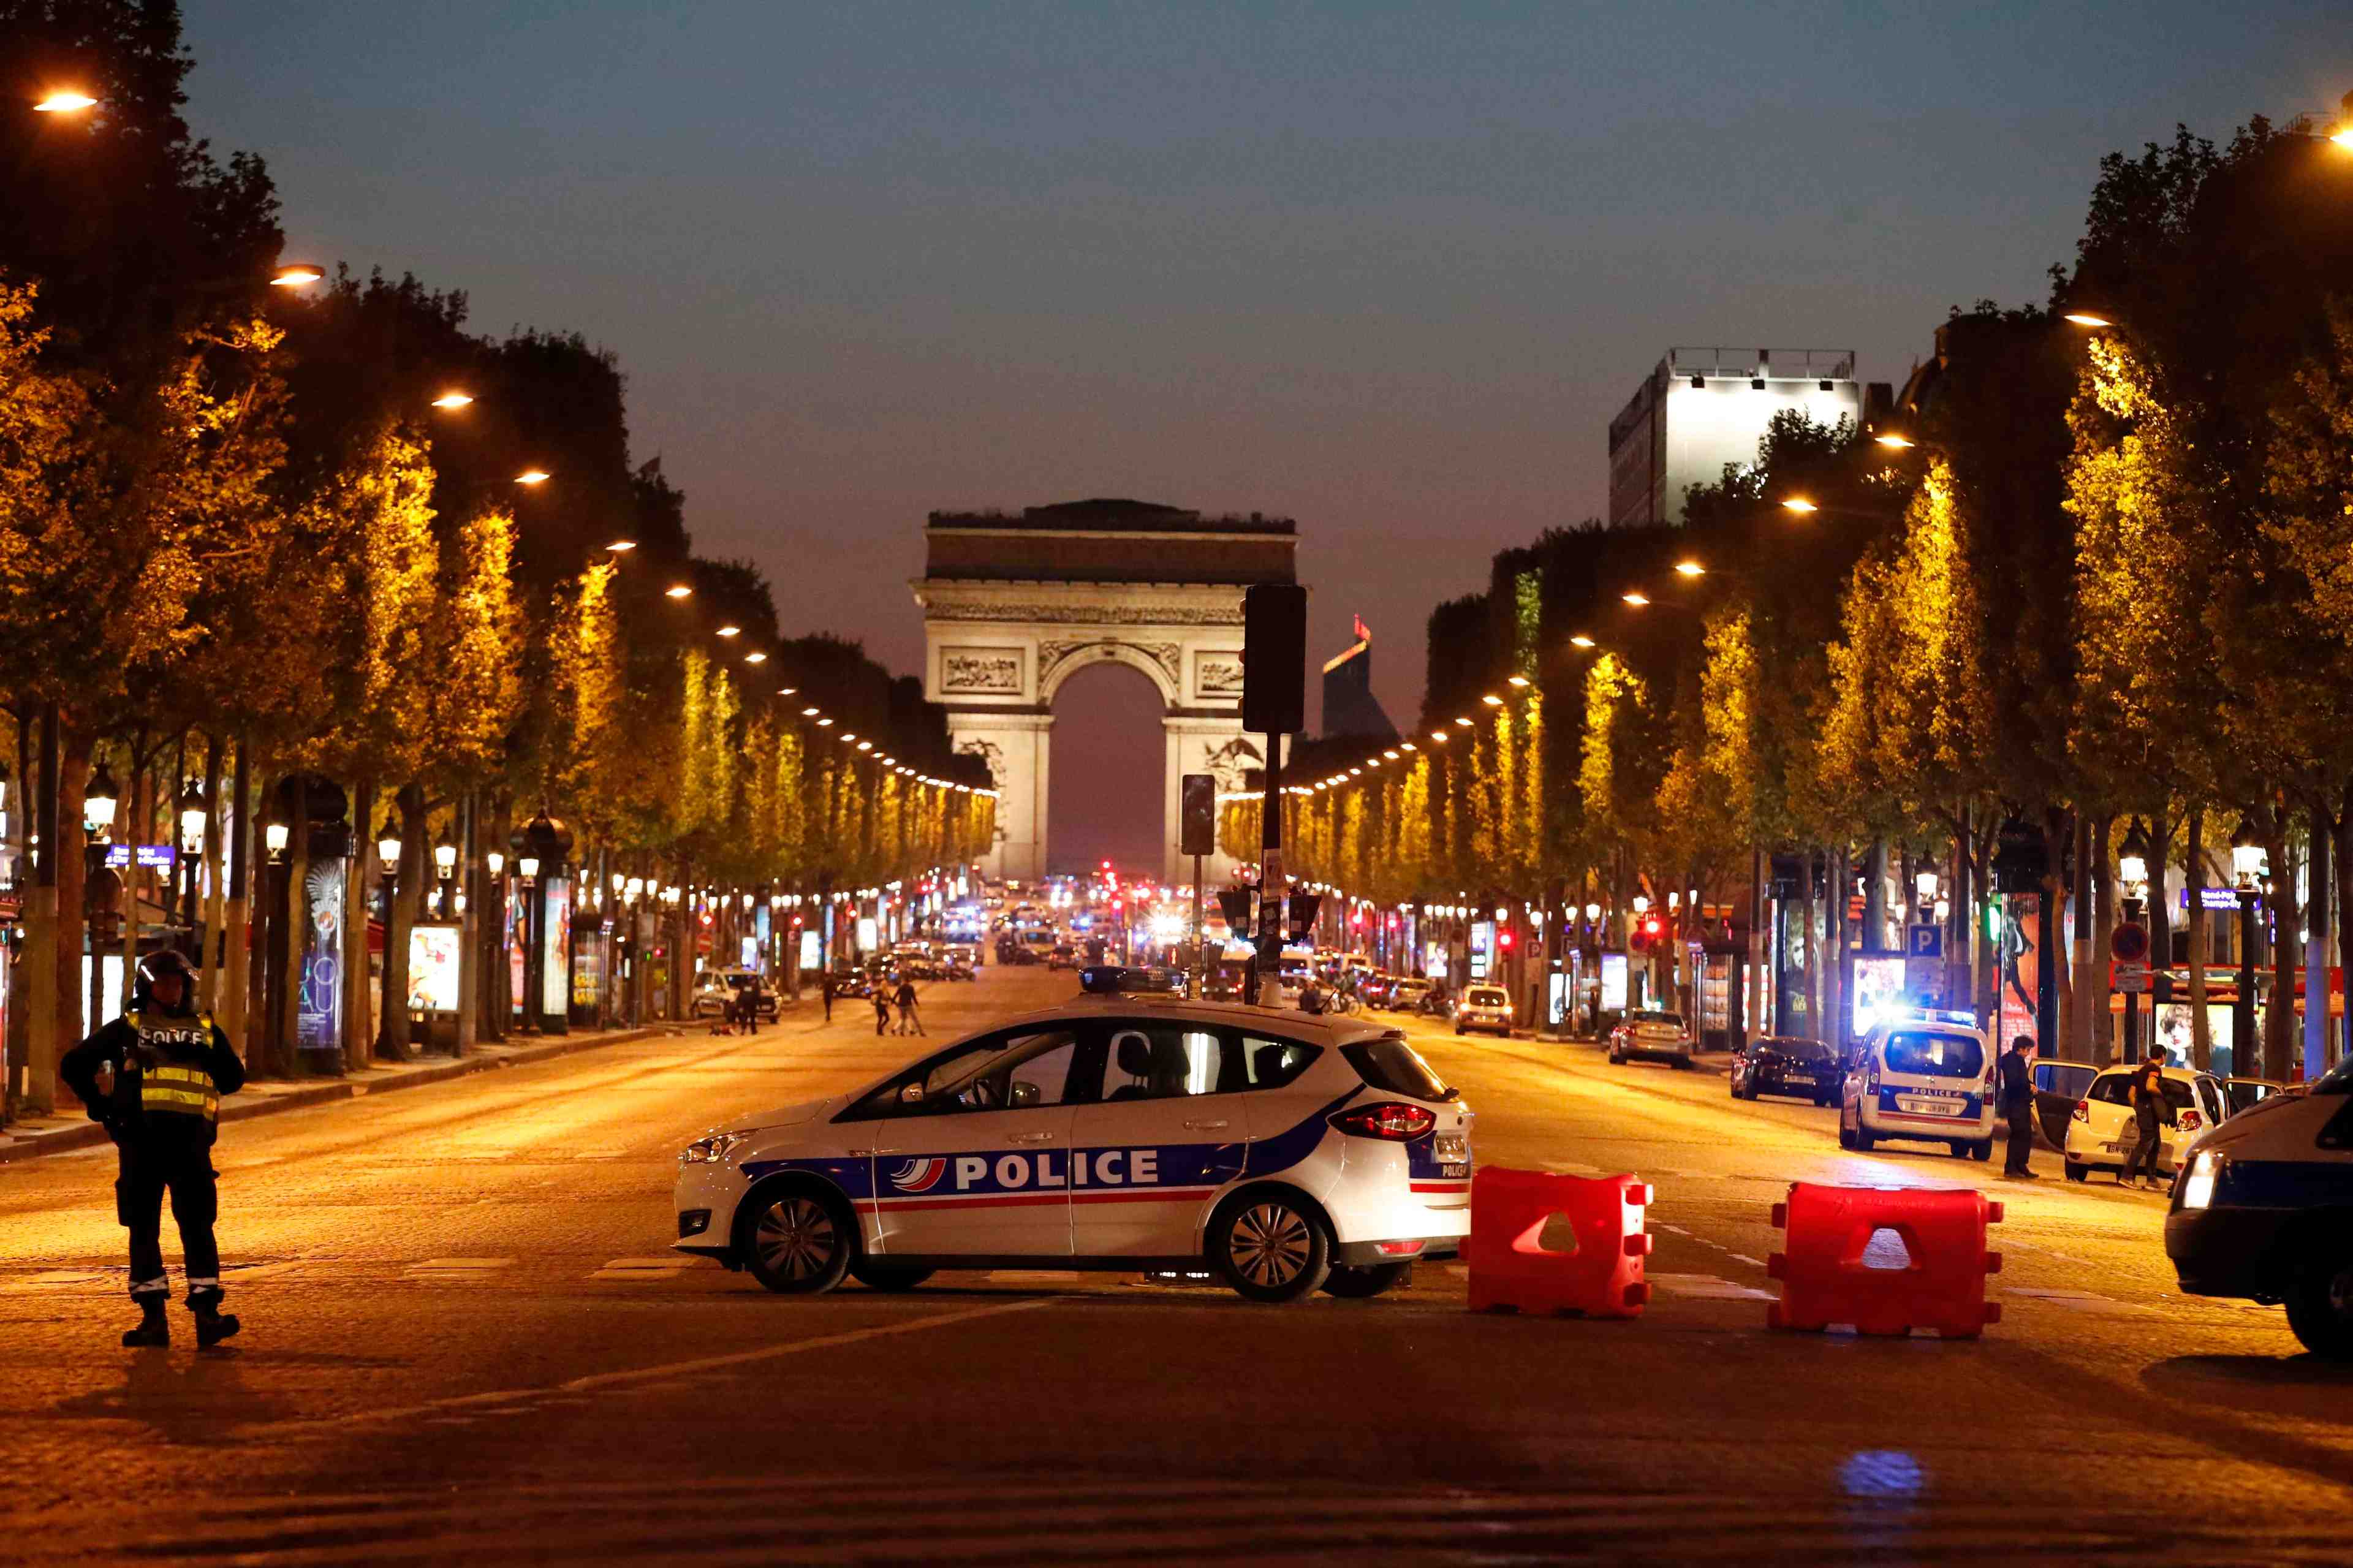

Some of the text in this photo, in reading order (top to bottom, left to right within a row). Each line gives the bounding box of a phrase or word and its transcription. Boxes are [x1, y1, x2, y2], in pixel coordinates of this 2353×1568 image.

[1918, 931, 1933, 952] P
[1912, 1088, 1952, 1097] POLICE
[956, 1149, 1159, 1190] POLICE
